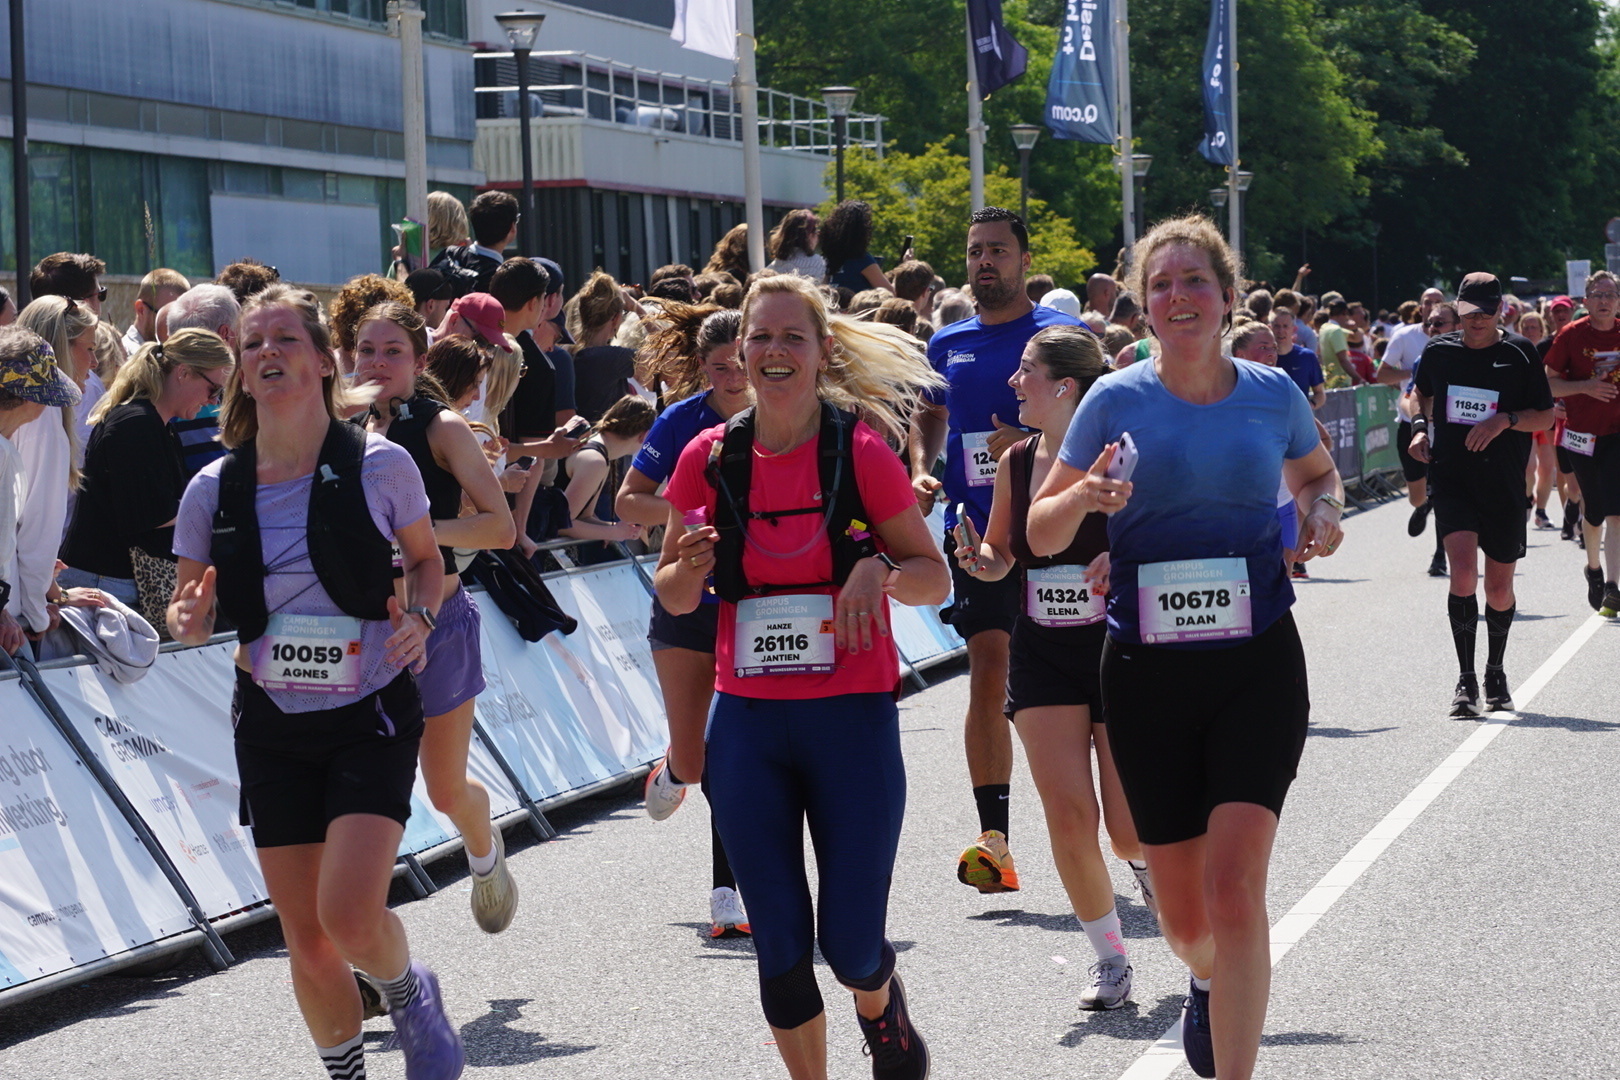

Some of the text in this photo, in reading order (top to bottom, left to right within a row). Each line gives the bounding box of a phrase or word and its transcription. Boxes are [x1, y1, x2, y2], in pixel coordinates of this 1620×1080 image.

[1455, 399, 1487, 412] 11843
[1566, 431, 1588, 445] 11026
[1163, 562, 1204, 572] CAMPUS
[1163, 569, 1223, 584] GRONINGEN
[1037, 588, 1089, 603] 14324
[1158, 589, 1231, 611] 10678
[755, 598, 790, 608] CAMPUS
[755, 606, 808, 619] GRONINGEN
[1047, 607, 1080, 616] ELENA
[283, 617, 319, 625] CAMPUS
[1175, 614, 1216, 626] DAAN
[281, 626, 336, 635] GRONINGEN
[753, 634, 809, 653] 26116
[272, 643, 343, 664] 10059
[761, 654, 800, 662] JANTIEN
[282, 668, 329, 679] AGNES
[9, 745, 53, 777] door
